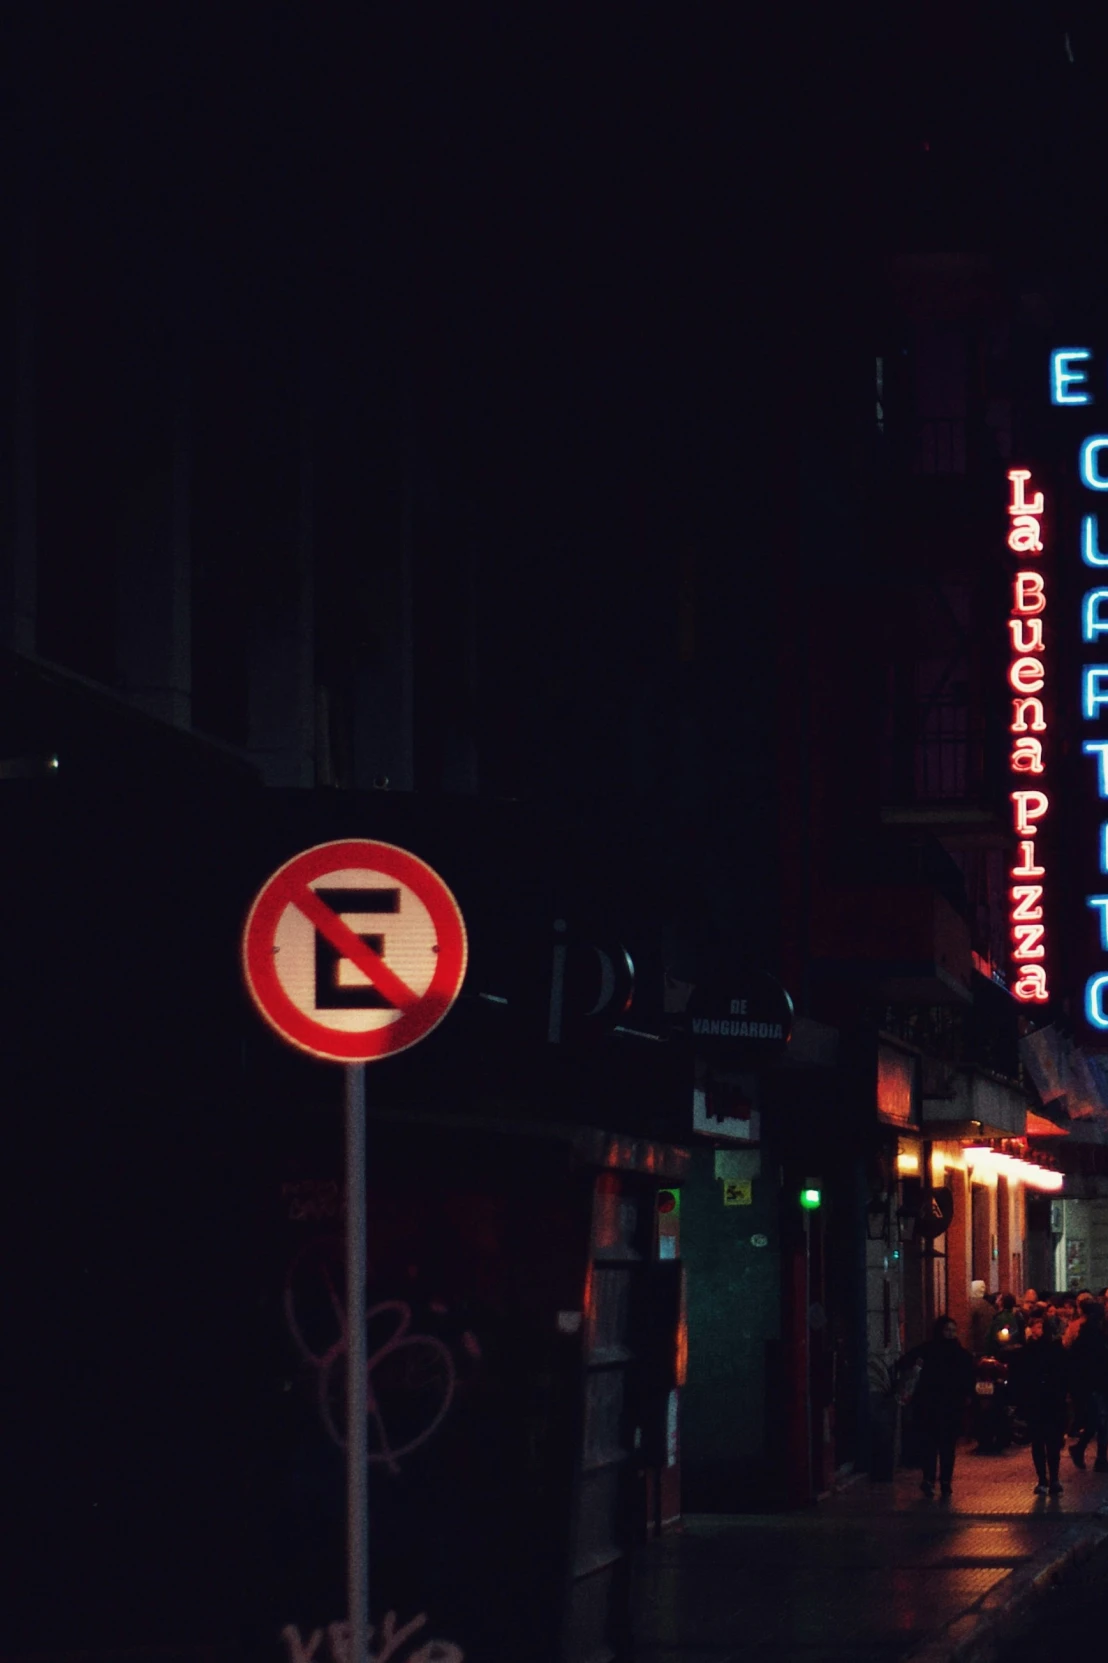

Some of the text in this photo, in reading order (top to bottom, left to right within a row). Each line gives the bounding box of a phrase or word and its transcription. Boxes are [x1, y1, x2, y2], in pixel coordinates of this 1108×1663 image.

[1006, 468, 1049, 1004] La Buena Pizza
[315, 888, 400, 1009] E
[692, 1018, 783, 1039] VANGUARDIA
[730, 999, 748, 1014] DE
